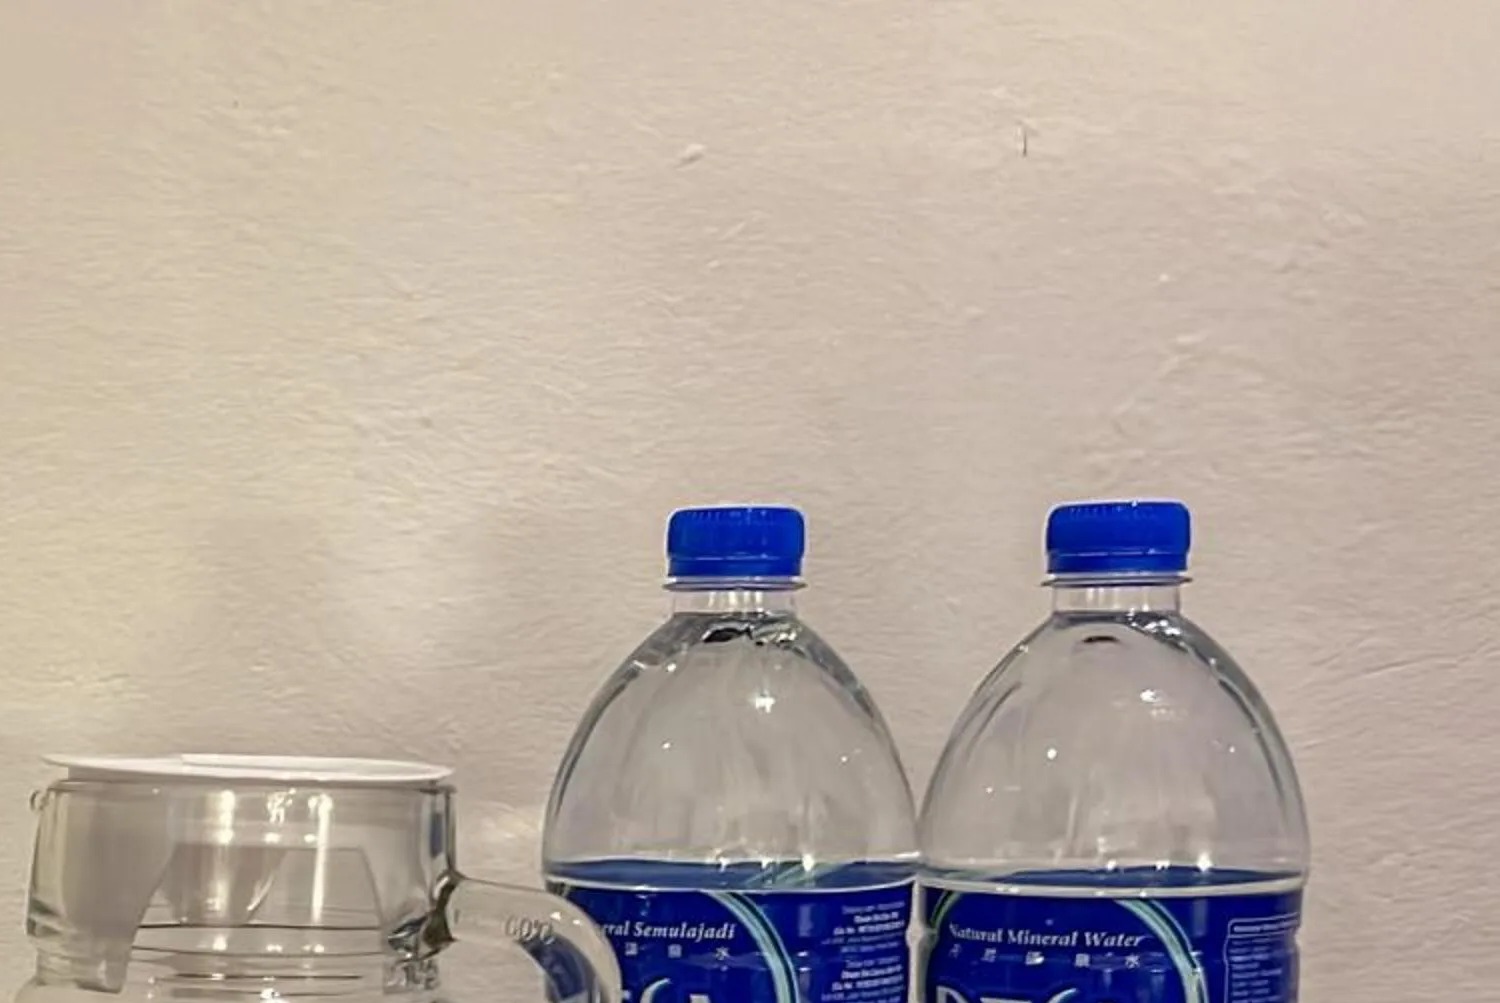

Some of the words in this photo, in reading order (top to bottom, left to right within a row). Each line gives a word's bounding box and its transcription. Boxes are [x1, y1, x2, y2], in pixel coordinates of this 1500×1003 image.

[633, 922, 736, 943] Semulajadi
[949, 923, 1003, 943] Natural
[1007, 929, 1078, 947] Mineral
[1084, 931, 1141, 948] Water
